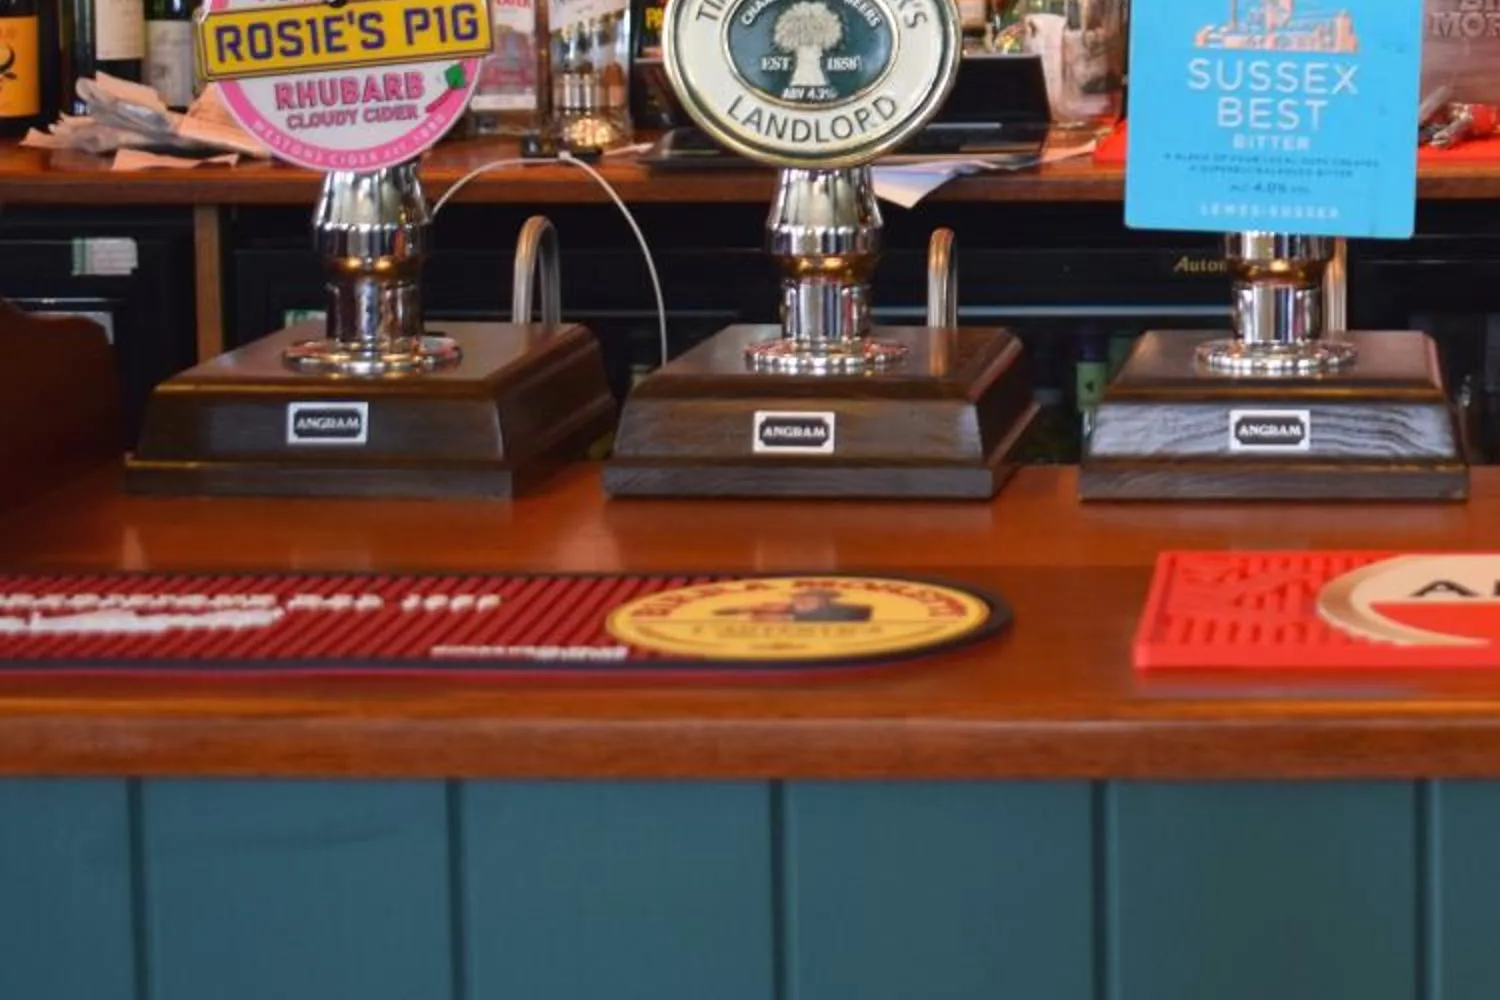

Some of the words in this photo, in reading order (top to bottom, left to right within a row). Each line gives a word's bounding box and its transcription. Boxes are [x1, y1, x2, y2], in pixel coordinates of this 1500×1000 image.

[1187, 58, 1358, 94] SUSSEX
[273, 71, 426, 111] RHUBARB
[286, 108, 358, 131] CLOUDY
[363, 103, 419, 124] CIDER
[727, 94, 898, 144] LANDLORD
[1217, 97, 1328, 131] BEST
[1233, 134, 1311, 150] BITTER
[297, 417, 361, 430] ANGRAM
[763, 425, 826, 439] ANGRAM
[1238, 424, 1303, 438] ANGRAM
